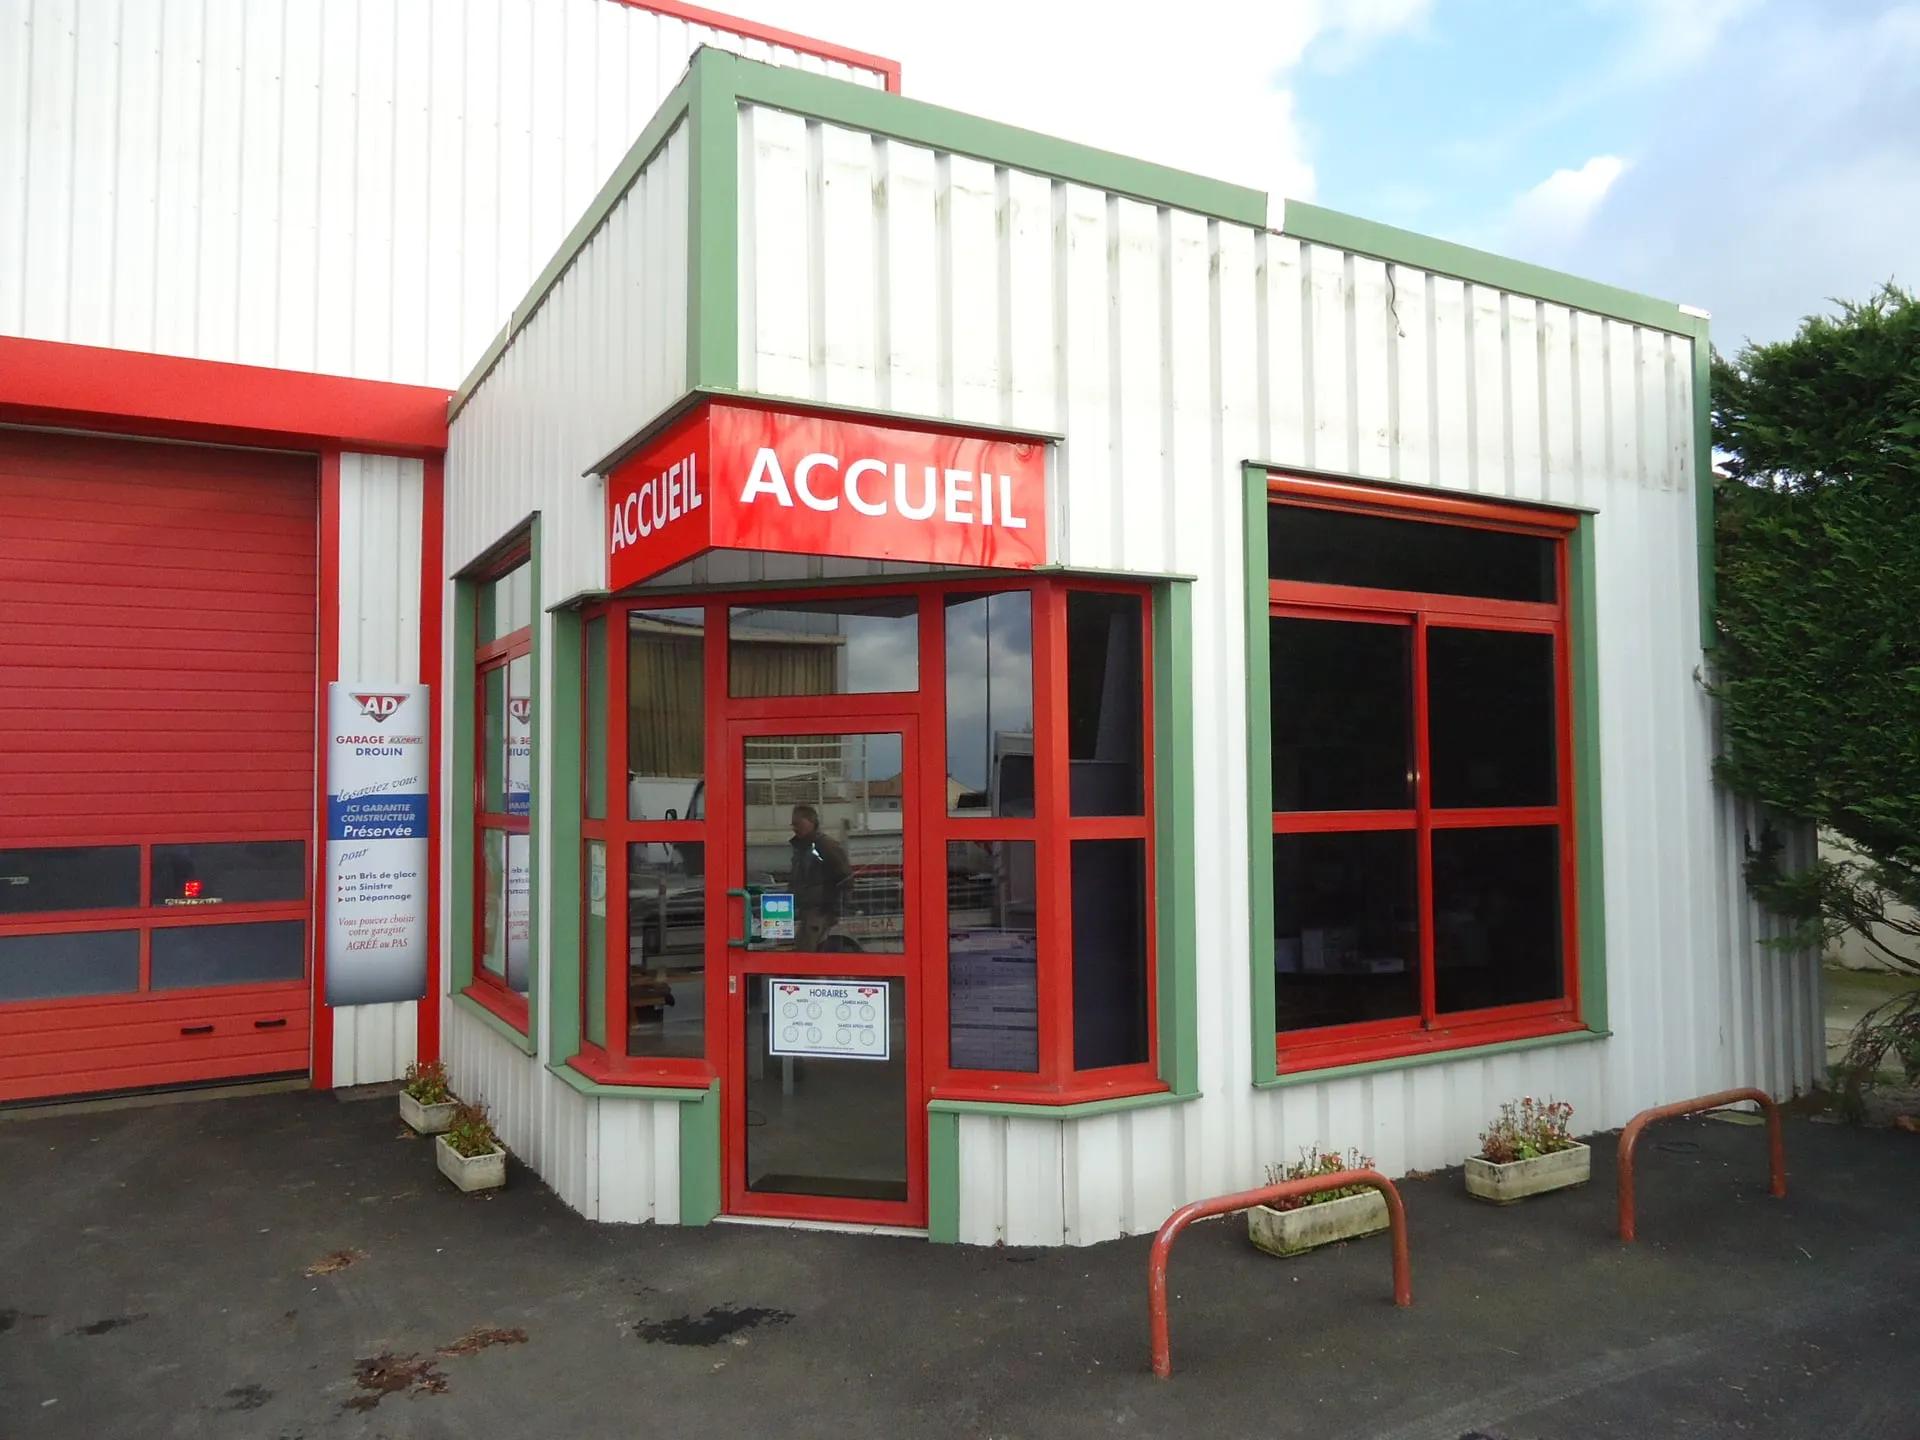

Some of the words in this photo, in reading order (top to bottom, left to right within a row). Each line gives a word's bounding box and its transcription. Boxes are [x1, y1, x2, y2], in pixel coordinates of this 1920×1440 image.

[739, 447, 1027, 529] ACCUEIL
[610, 452, 702, 554] ACCUEIL
[360, 695, 399, 716] AD
[336, 735, 385, 744] GARAGE
[355, 747, 403, 756] DROUIN
[350, 782, 389, 799] saviez
[392, 775, 418, 788] vous
[346, 804, 360, 812] ICI
[362, 803, 411, 812] GARANTIE
[341, 813, 416, 823] CONSTRUCTEUR
[343, 824, 412, 838] Préservée
[338, 848, 368, 867] pour
[359, 872, 377, 880] Bris
[393, 871, 417, 880] glace
[359, 882, 393, 891] Sinistre
[391, 938, 408, 948] PAS
[809, 989, 849, 999] HORAIRES
